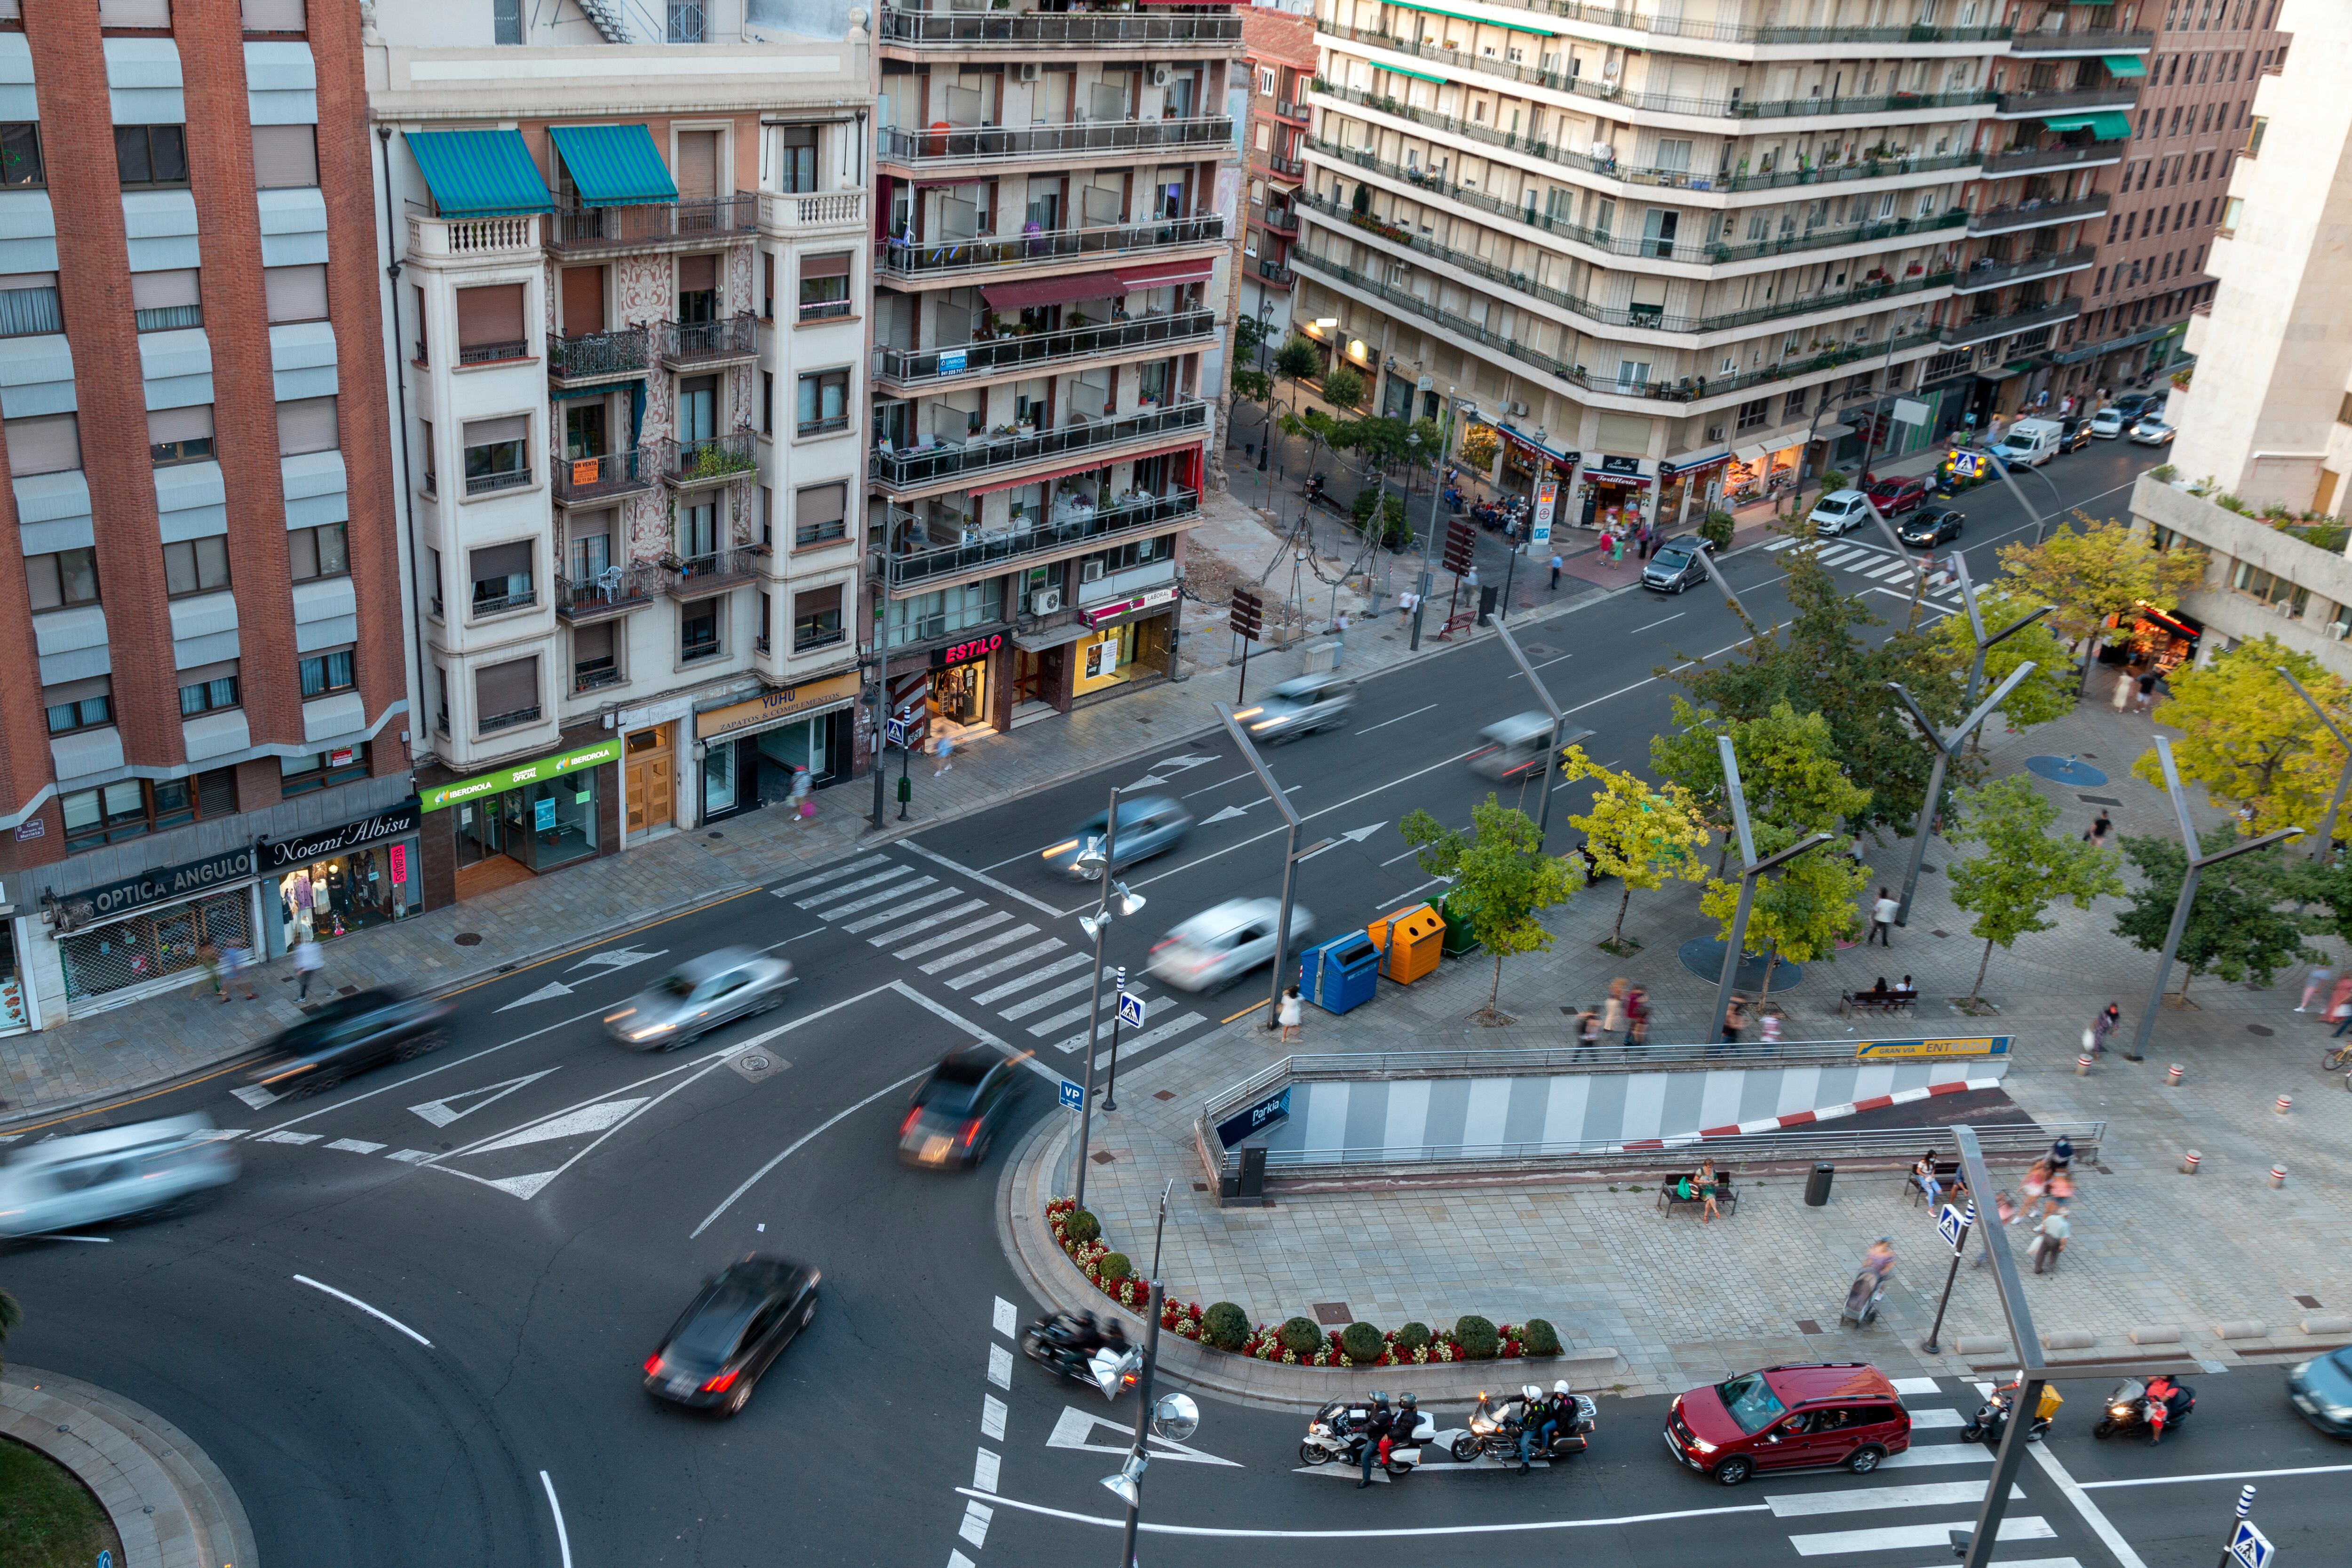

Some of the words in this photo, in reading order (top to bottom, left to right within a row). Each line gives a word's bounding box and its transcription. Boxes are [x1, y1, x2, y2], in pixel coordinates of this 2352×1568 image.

[1606, 462, 1633, 471] Concordia
[1596, 475, 1637, 486] Tortillería
[1147, 591, 1169, 601] LABORAL
[945, 635, 1001, 663] ESTILO
[720, 715, 759, 731] ZAPATOS
[771, 692, 840, 716] COMPLEMENTOS
[571, 749, 609, 765] IBERDROLA
[512, 767, 536, 777] COLABORADOR
[513, 770, 537, 782] OFICIAL
[450, 781, 492, 798] IBERDROLA
[274, 829, 346, 865] Noemí
[345, 816, 410, 844] Albisu
[393, 847, 405, 881] REBAJAS
[97, 881, 167, 911] OPTICA
[175, 855, 248, 891] ANGULO
[1926, 1041, 1988, 1053] ENTRADA
[1065, 1086, 1080, 1099] VP
[1252, 1100, 1279, 1122] Parkia
